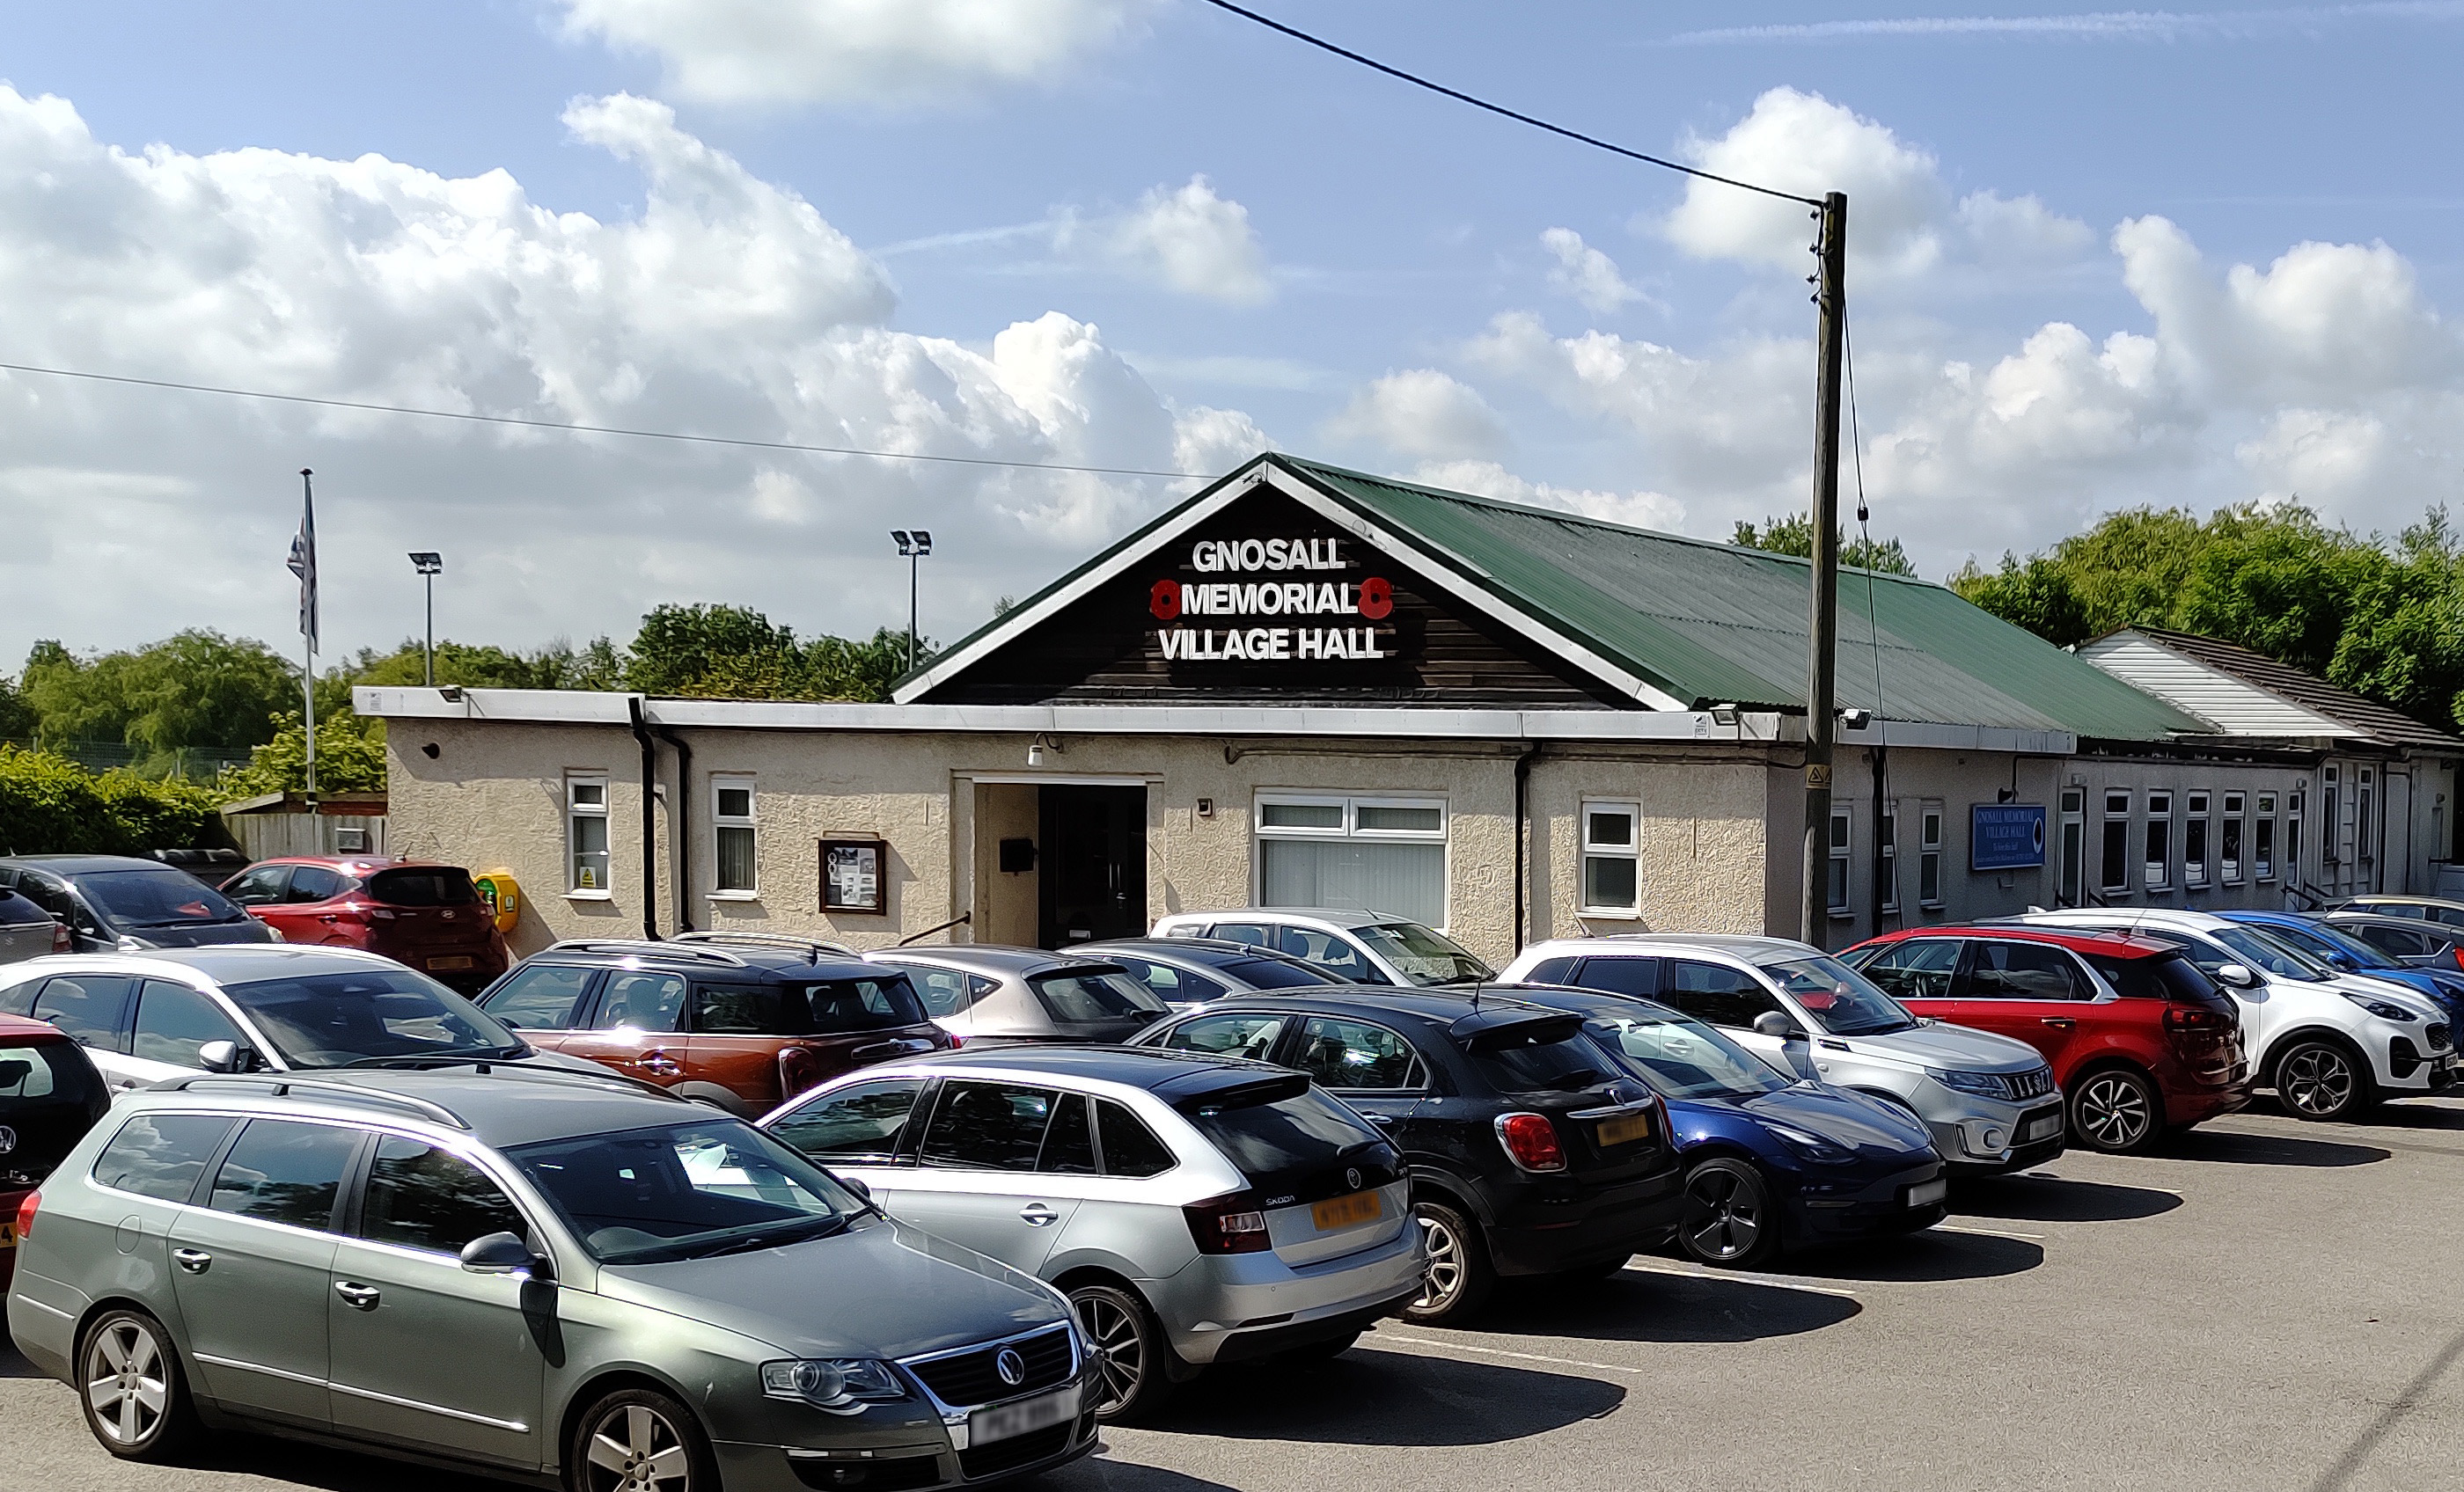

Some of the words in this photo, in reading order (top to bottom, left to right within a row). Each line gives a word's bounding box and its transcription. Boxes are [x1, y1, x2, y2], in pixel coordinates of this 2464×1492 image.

[1192, 538, 1346, 573] GNOSALL
[1182, 582, 1359, 615] MEMORIAL
[1158, 627, 1291, 661] VILLAGE
[1298, 626, 1384, 660] HALL
[1985, 826, 2009, 839] VILLAGE
[2010, 825, 2026, 838] HALL
